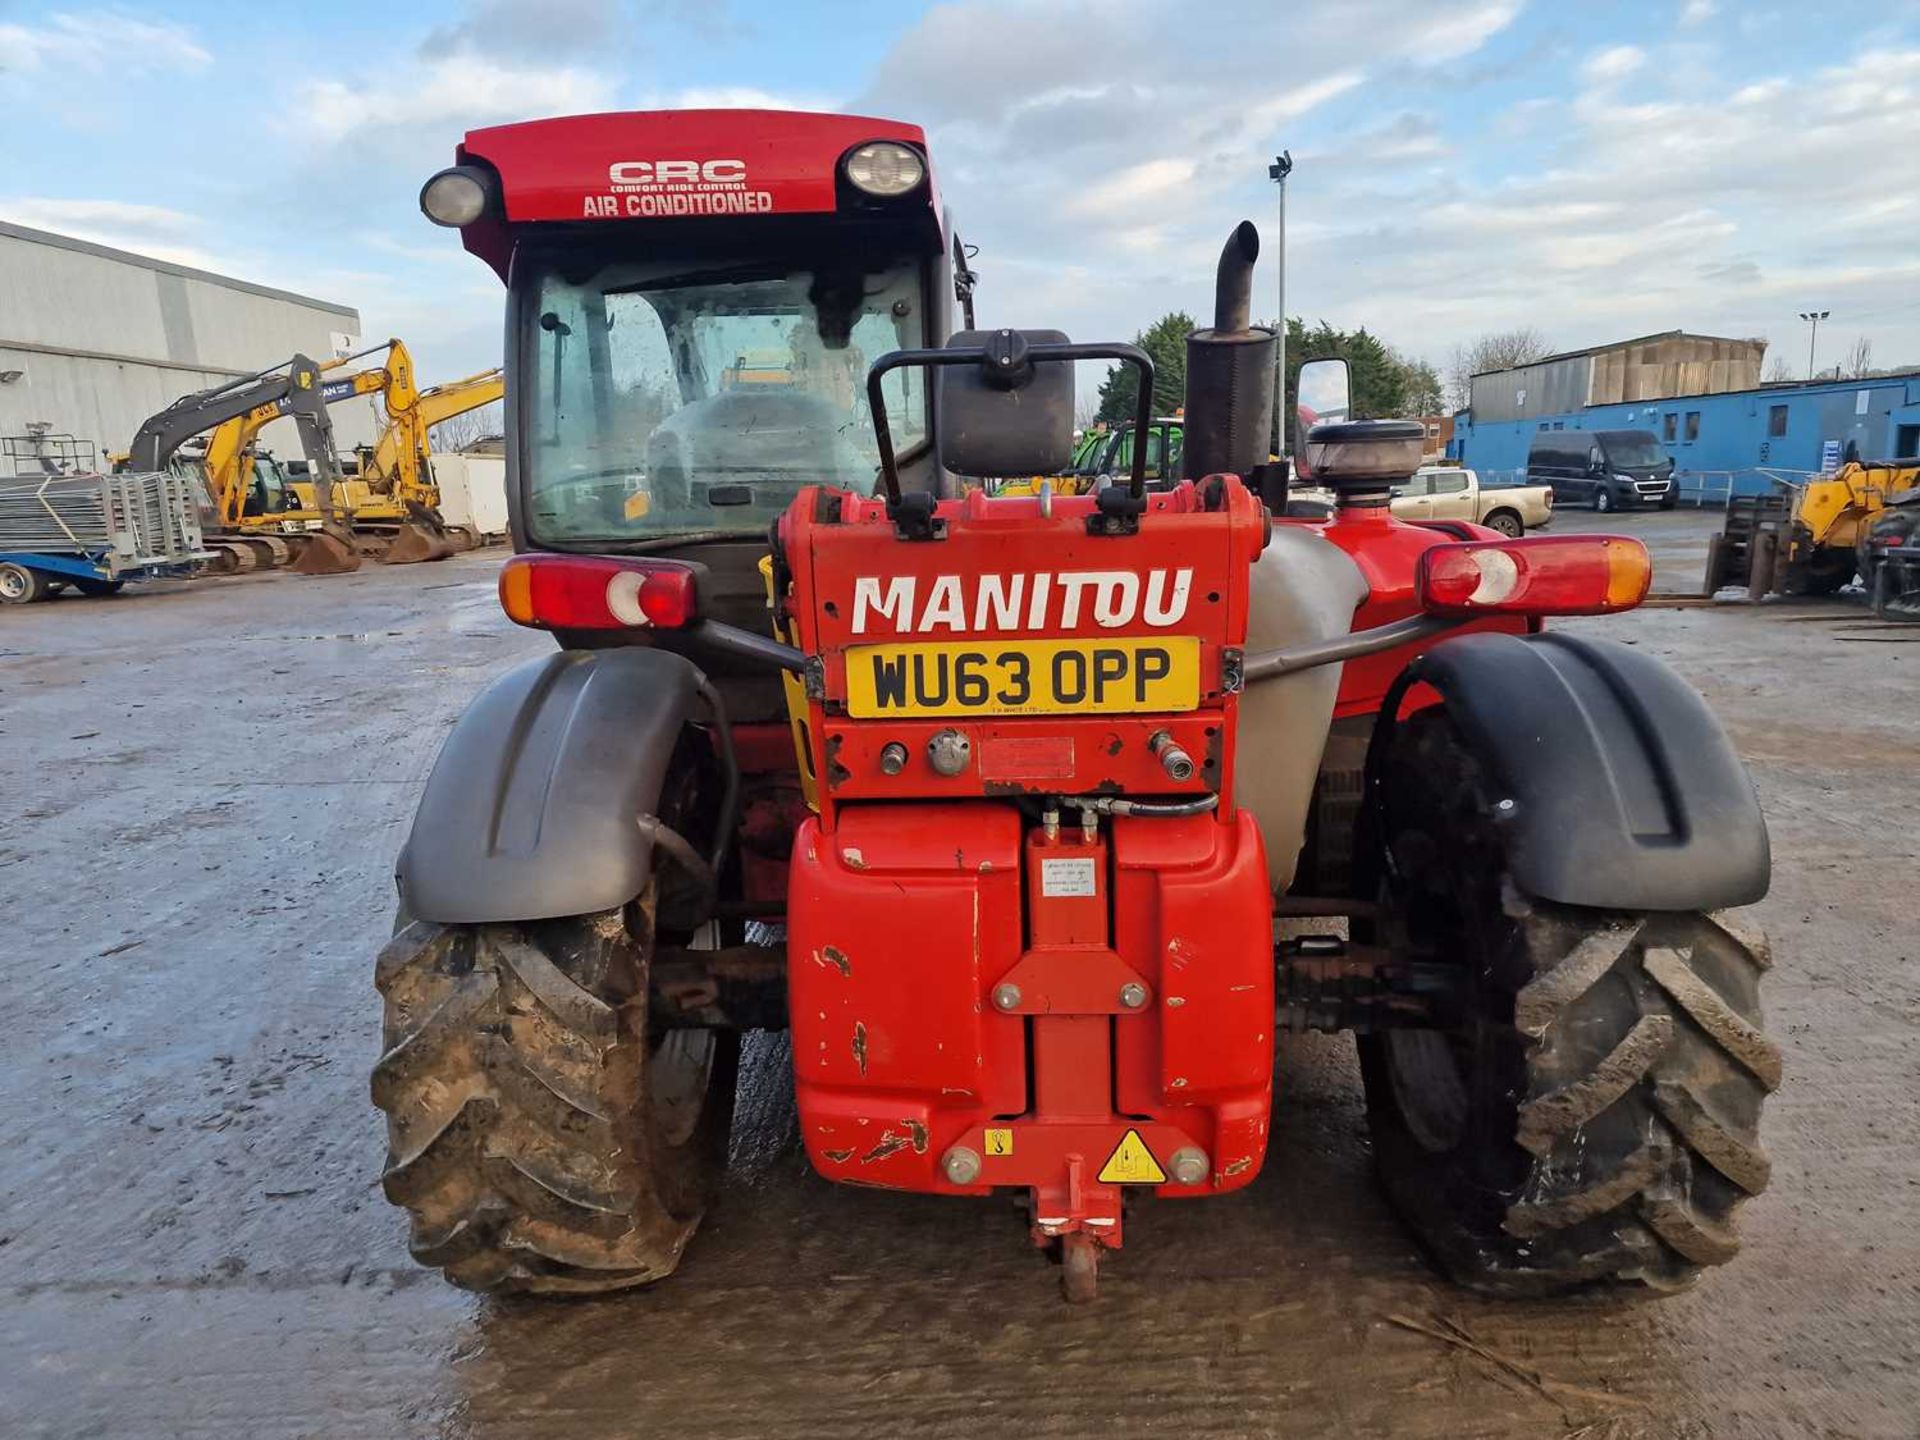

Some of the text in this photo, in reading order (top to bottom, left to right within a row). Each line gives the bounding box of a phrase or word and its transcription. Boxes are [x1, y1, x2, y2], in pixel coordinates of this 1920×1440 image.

[609, 159, 747, 184] CRC
[610, 184, 664, 193] COMFORT
[697, 182, 747, 192] CONTROL
[583, 191, 773, 217] AIR CONDITIONED
[851, 568, 1194, 634] MANITOU
[872, 647, 1171, 708] WU63 OPP
